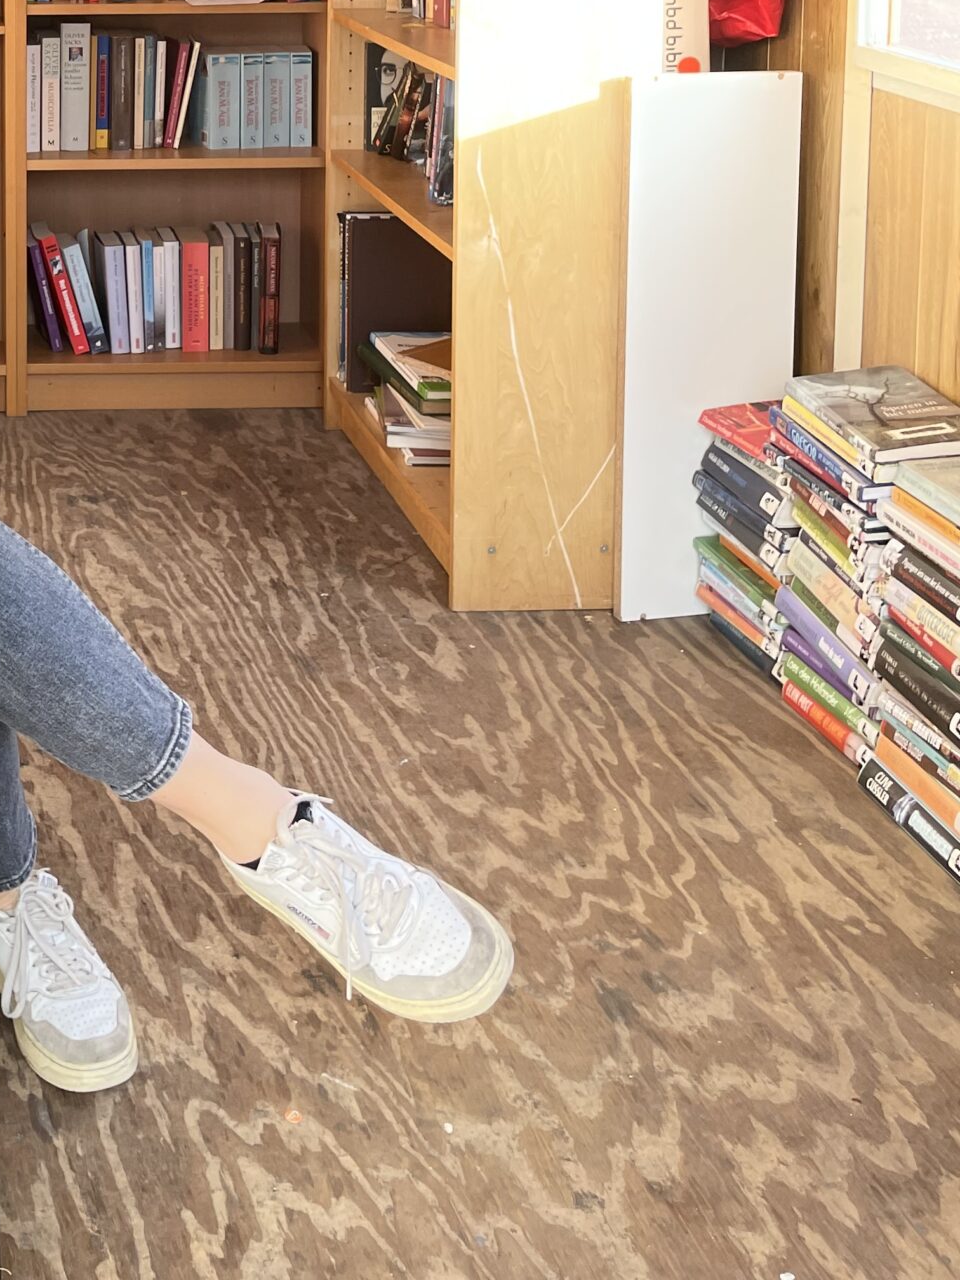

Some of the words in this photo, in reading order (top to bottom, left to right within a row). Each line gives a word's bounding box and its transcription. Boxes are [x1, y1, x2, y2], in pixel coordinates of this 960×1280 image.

[810, 673, 838, 708] Hollander
[866, 778, 889, 807] CUSSLER
[875, 771, 893, 790] CLIVE
